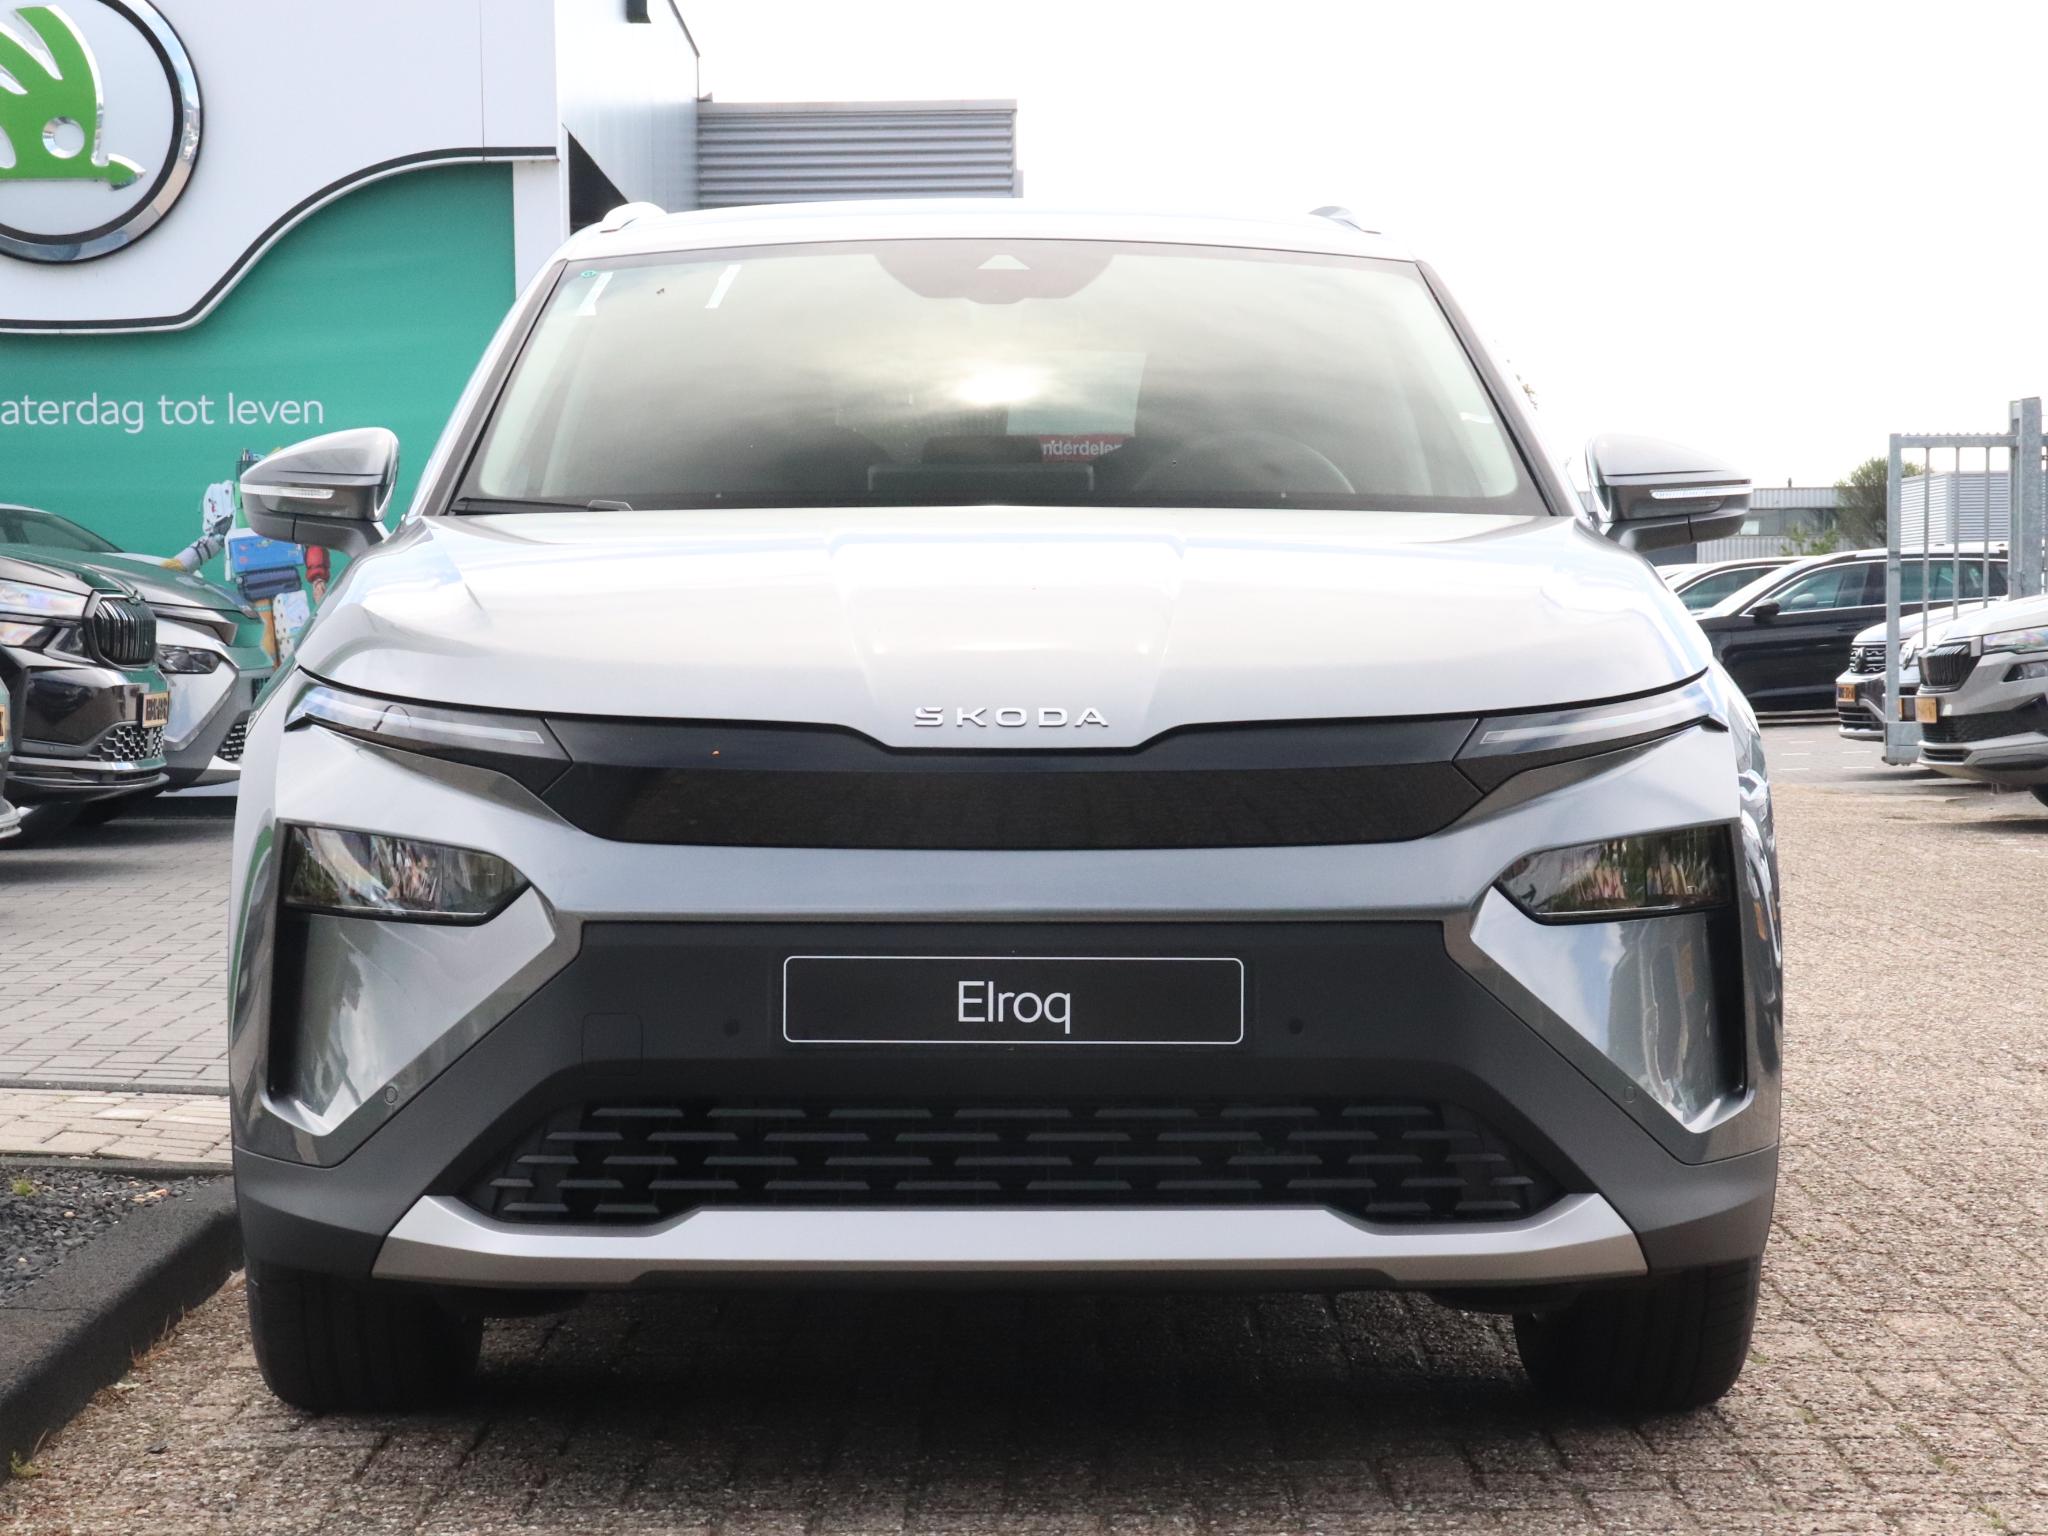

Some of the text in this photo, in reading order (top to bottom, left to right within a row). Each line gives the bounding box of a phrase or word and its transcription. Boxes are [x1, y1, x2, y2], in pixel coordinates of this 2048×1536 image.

[1, 391, 324, 434] aterdag tot leven
[958, 980, 1071, 1035] Elroq
